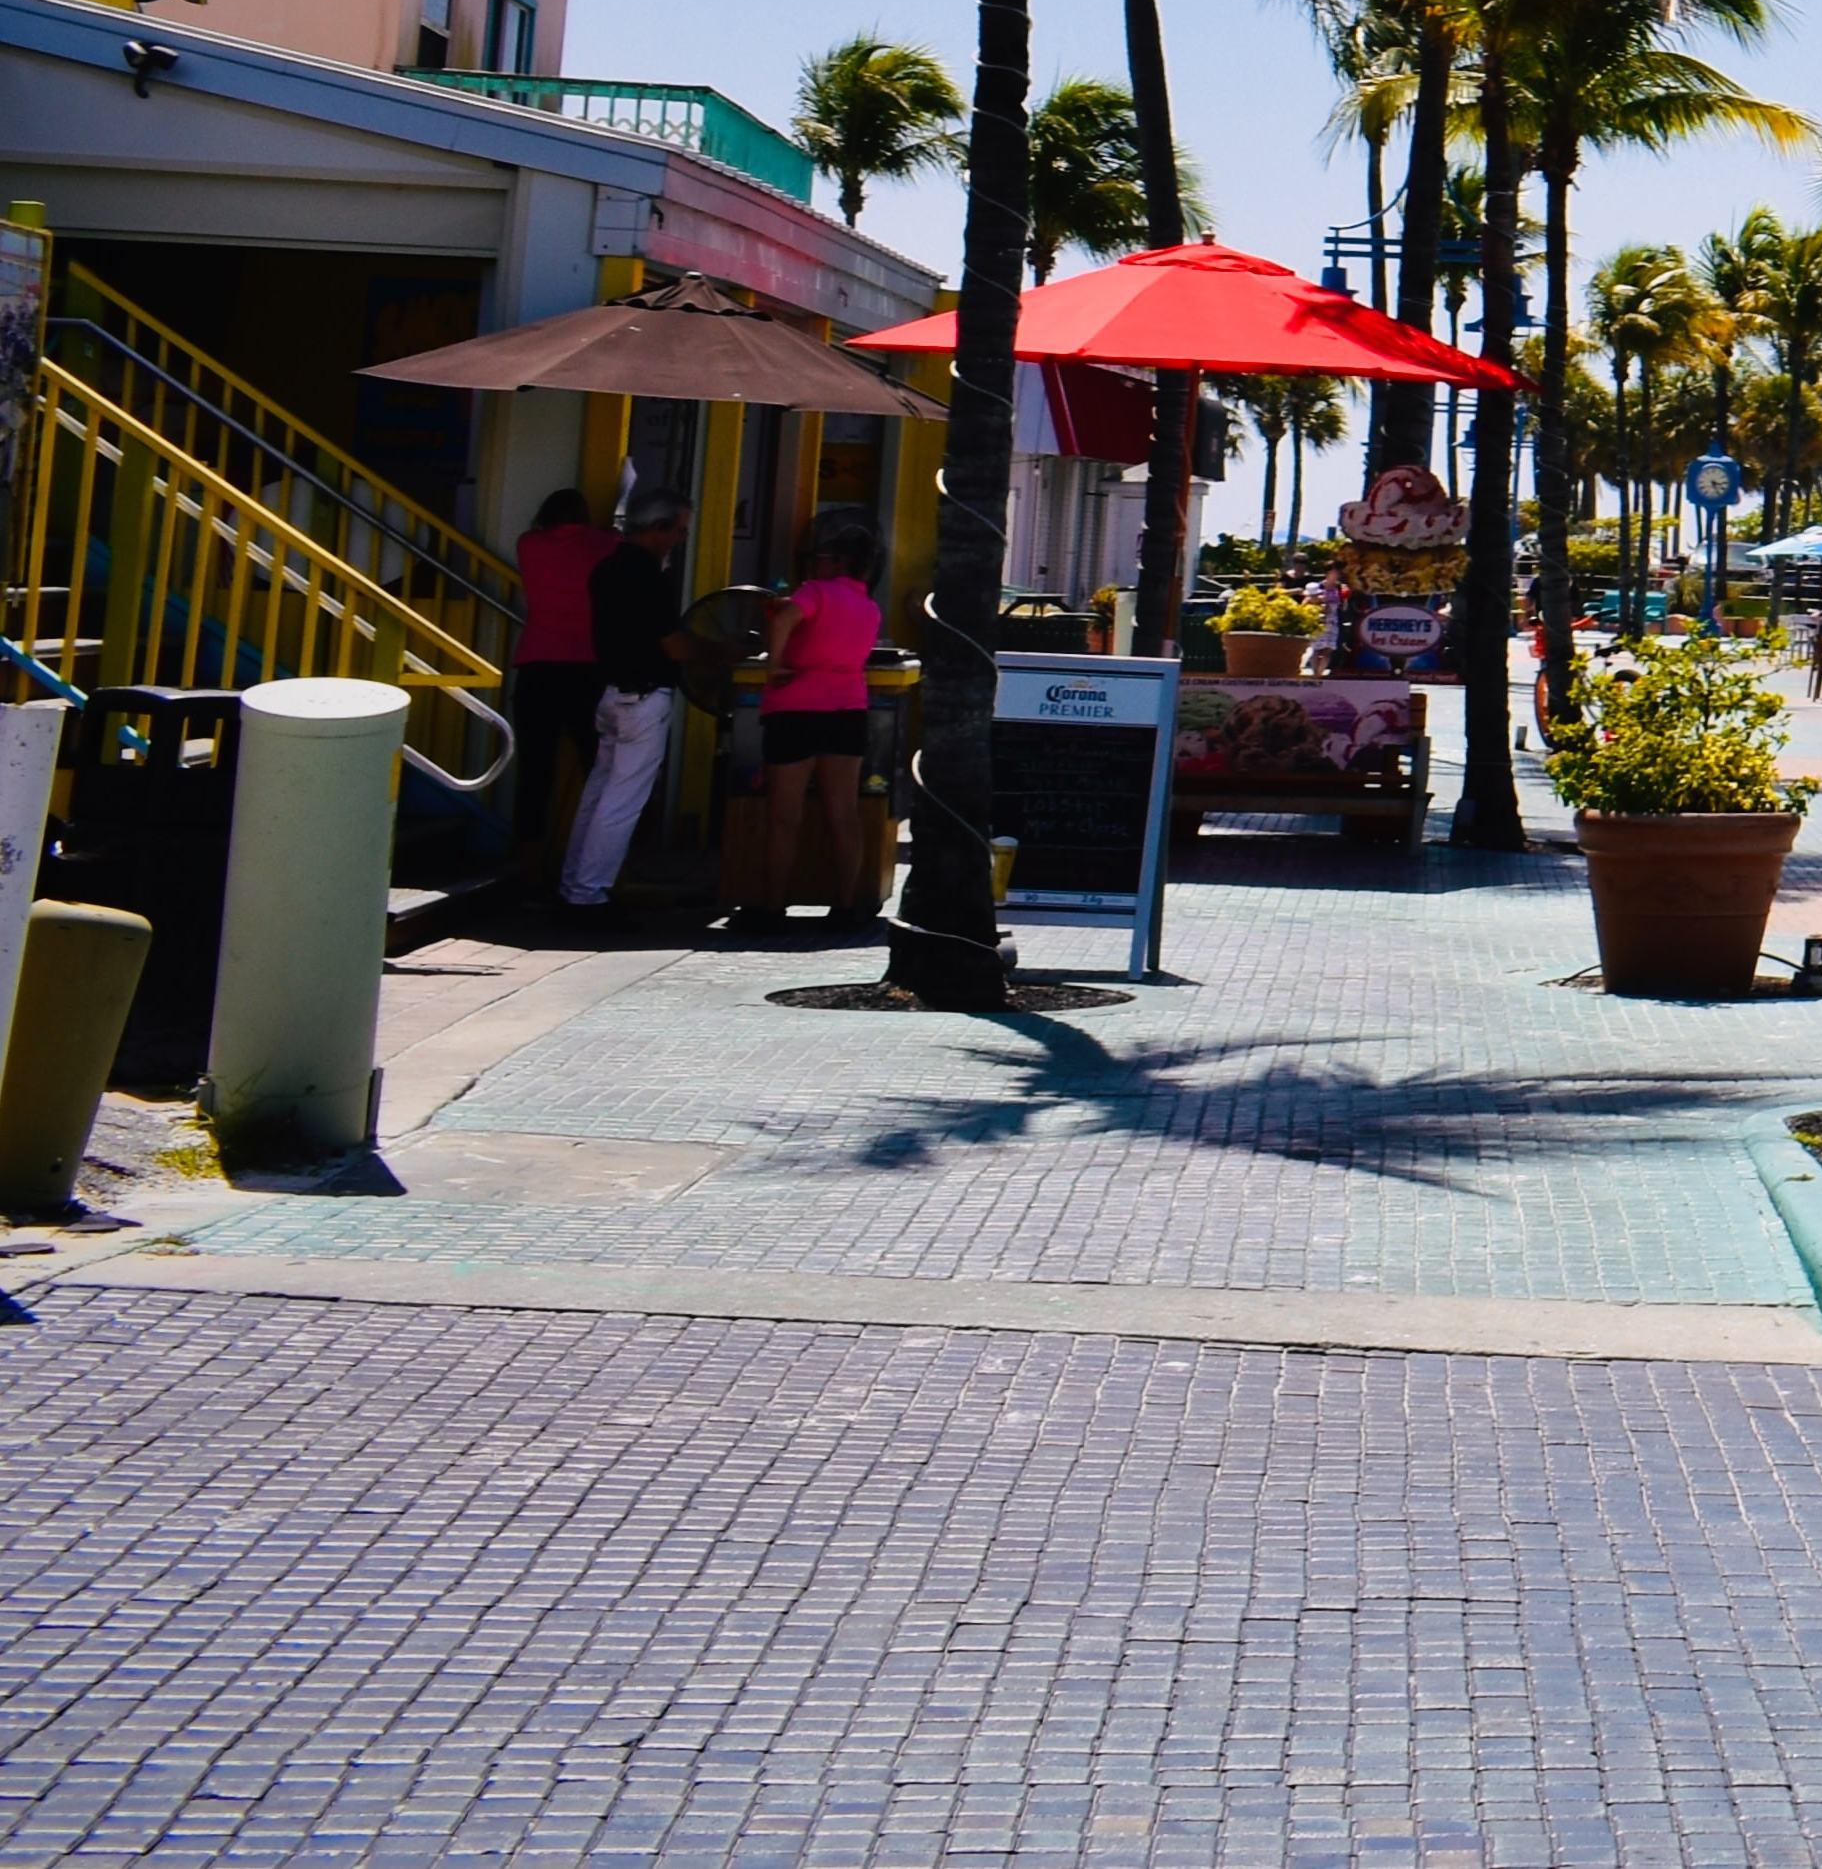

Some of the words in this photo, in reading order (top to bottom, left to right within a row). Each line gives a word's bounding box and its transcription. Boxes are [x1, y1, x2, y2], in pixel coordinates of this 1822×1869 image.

[1390, 634, 1428, 646] Cream
[1046, 685, 1107, 703] Corona
[1039, 703, 1115, 718] PREMIER
